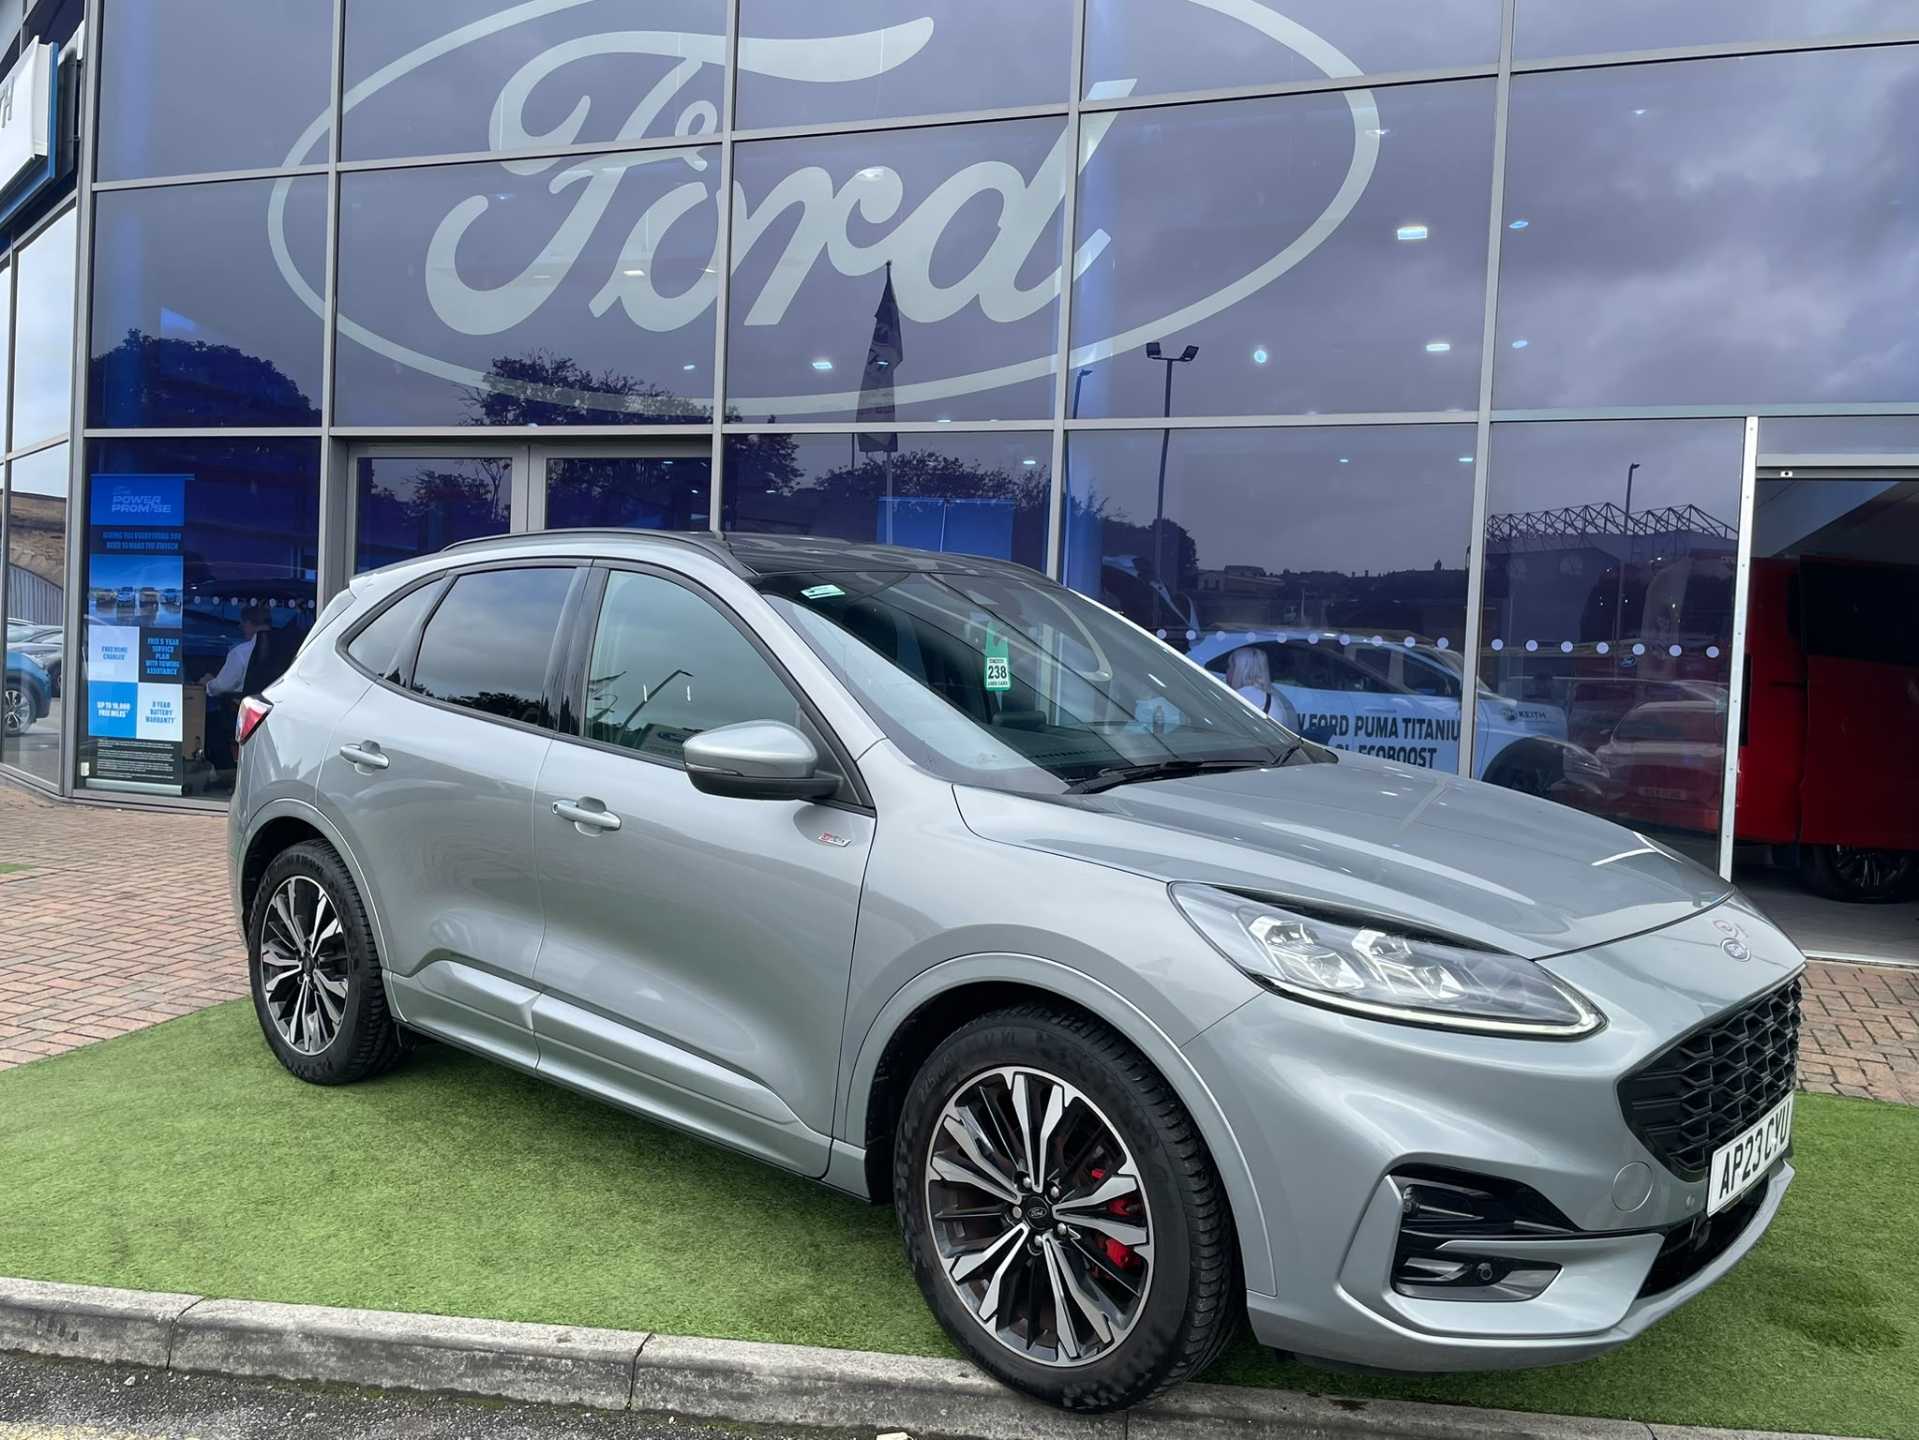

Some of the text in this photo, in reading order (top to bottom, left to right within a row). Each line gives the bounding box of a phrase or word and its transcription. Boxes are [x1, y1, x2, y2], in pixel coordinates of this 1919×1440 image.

[425, 17, 1139, 335] Ford
[111, 504, 172, 513] PROMISE
[112, 495, 162, 504] POWER
[988, 665, 1007, 679] 238
[1354, 715, 1399, 739] PUMA
[1402, 717, 1461, 742] TITANIU
[1719, 1127, 1764, 1200] AP23
